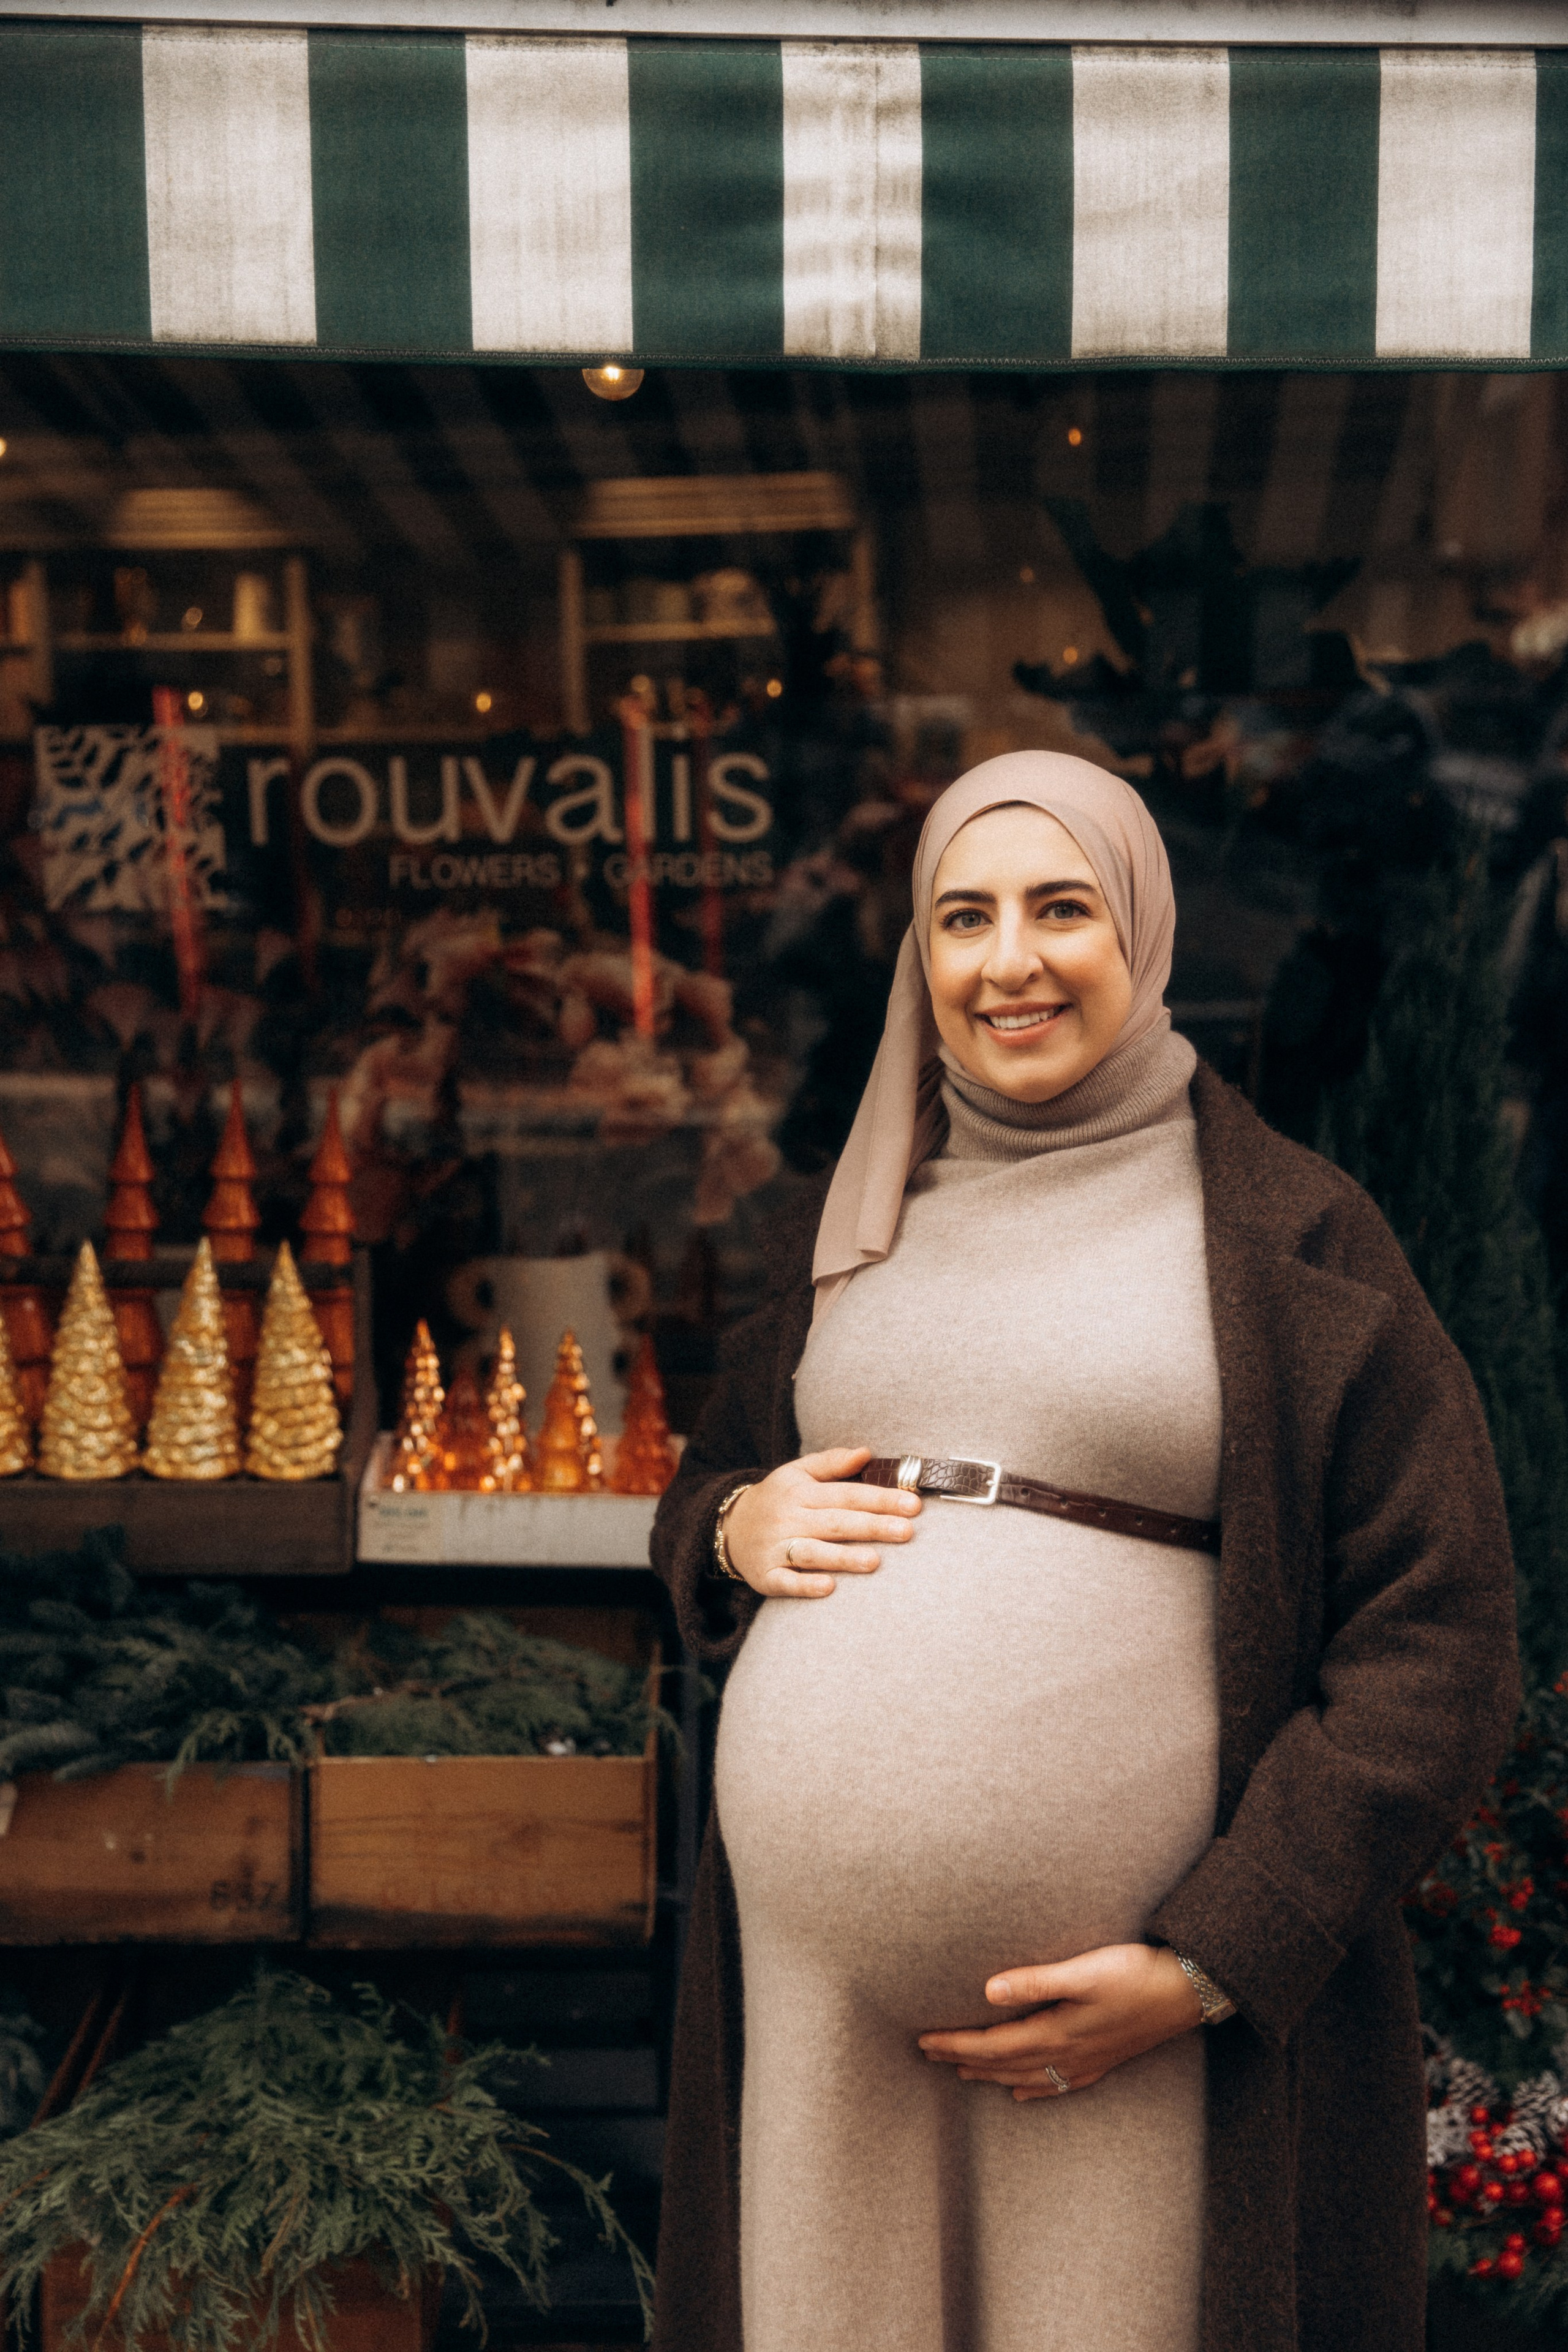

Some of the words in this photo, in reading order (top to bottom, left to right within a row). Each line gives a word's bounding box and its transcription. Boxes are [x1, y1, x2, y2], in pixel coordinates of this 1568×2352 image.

[247, 724, 773, 845] rouvalis
[389, 854, 559, 889] FLOWERS
[603, 852, 774, 888] GARDENS
